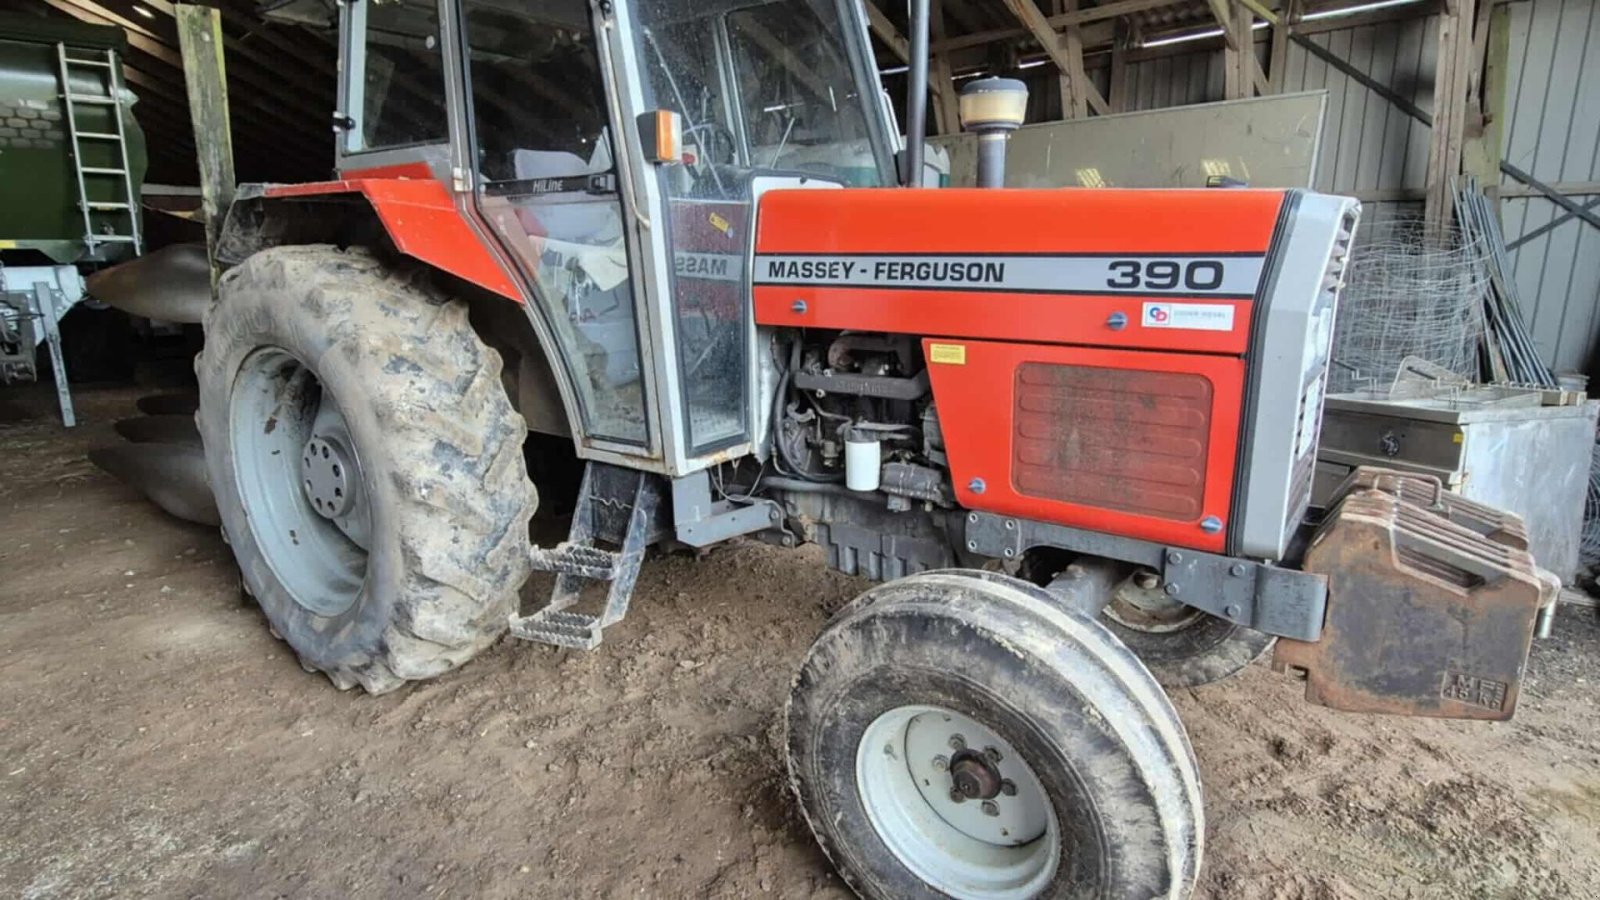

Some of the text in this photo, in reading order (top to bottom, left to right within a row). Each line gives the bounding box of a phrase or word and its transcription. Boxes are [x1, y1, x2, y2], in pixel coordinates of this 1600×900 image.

[768, 261, 855, 280] MASSEY
[874, 262, 1005, 283] FERGUSON
[1106, 260, 1224, 290] 390
